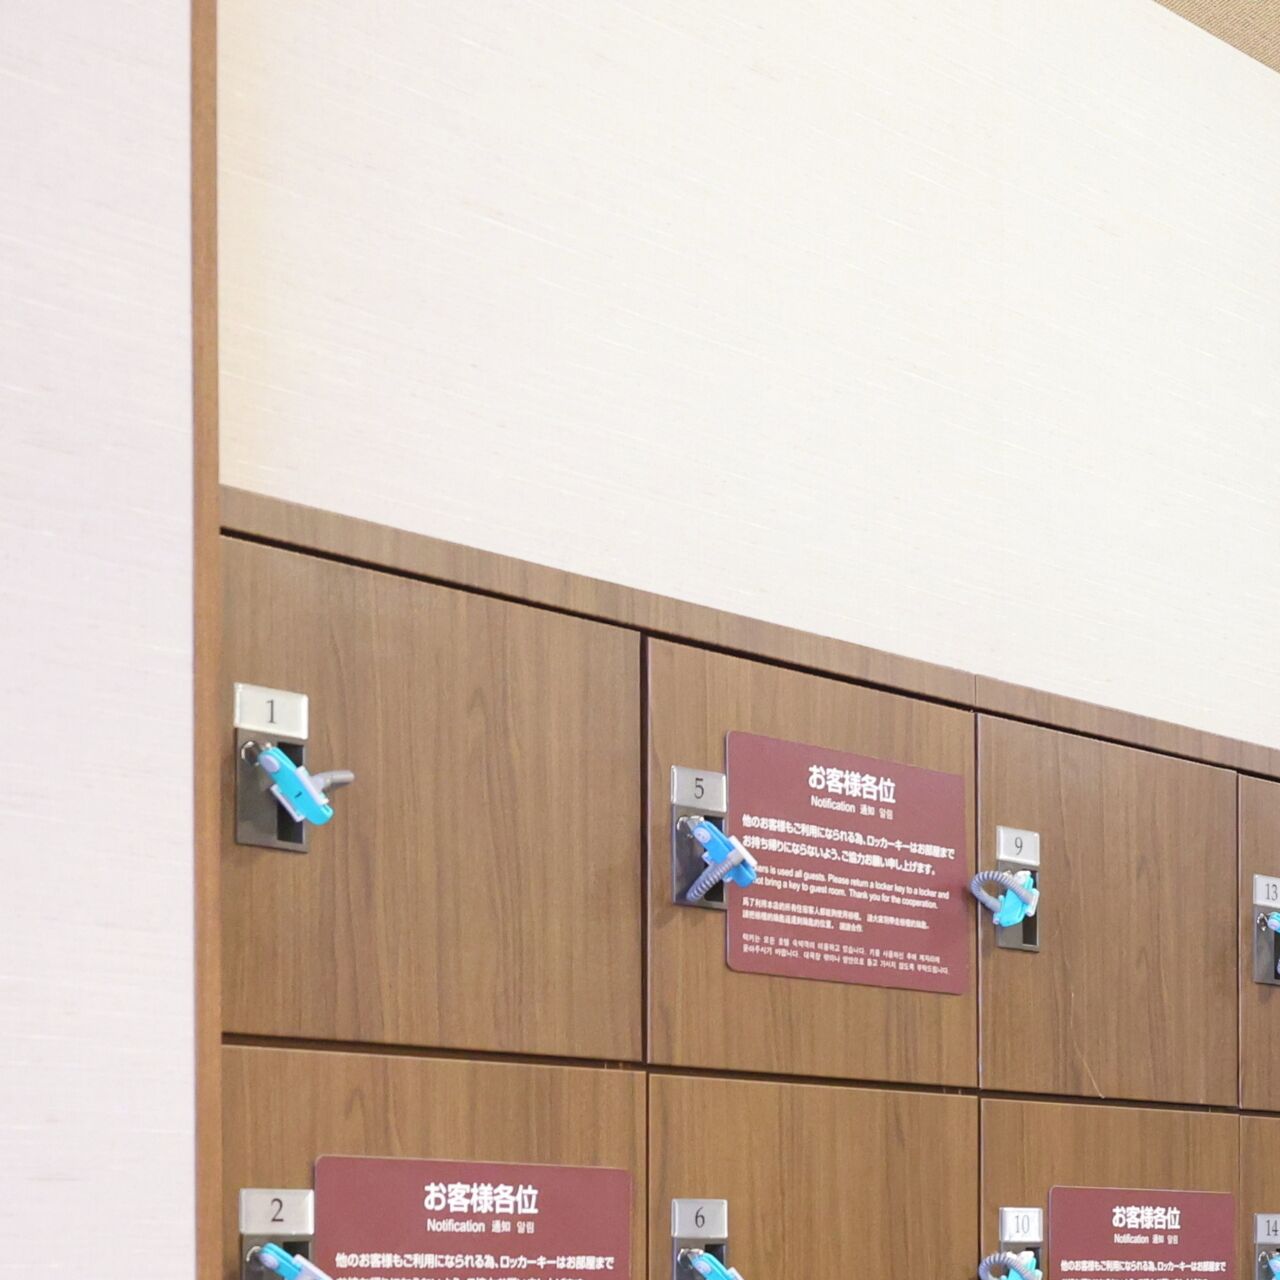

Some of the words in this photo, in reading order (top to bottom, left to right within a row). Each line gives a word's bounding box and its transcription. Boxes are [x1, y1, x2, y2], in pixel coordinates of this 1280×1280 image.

[266, 700, 278, 725] 1
[694, 778, 705, 799] 5
[808, 764, 896, 804] お客様各位
[810, 795, 856, 813] Notification
[1014, 837, 1024, 855] 9
[827, 872, 849, 885] Please
[1265, 883, 1278, 900] 13
[424, 1182, 539, 1215] お客様各位
[270, 1198, 284, 1222] 2
[694, 1208, 705, 1229] 6
[1112, 1205, 1181, 1230] お客様各位
[427, 1218, 485, 1232] Notification
[492, 1220, 511, 1233] 通知
[516, 1221, 535, 1234] 알림
[1015, 1215, 1030, 1234] 10
[1265, 1218, 1279, 1236] 14
[1114, 1233, 1149, 1244] Notification
